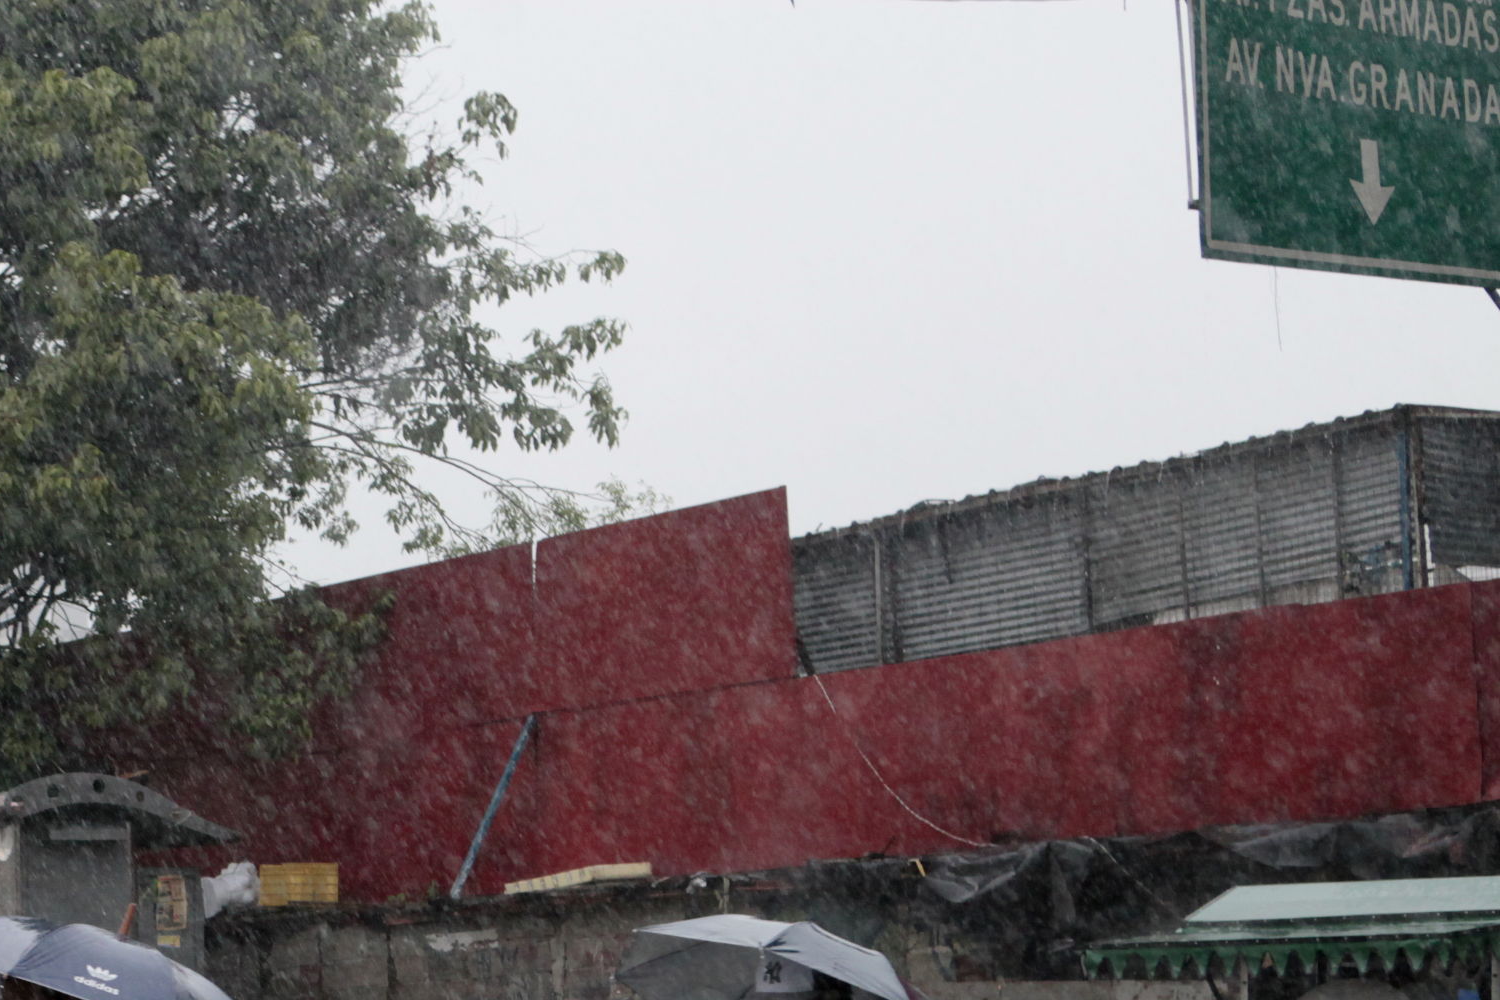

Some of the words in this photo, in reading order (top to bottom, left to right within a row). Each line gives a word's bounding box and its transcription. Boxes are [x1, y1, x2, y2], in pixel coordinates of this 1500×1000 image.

[1358, 0, 1499, 53] ARMADAS
[1225, 37, 1264, 89] AV.
[1349, 60, 1500, 125] GRANADA
[73, 975, 119, 995] adidas
